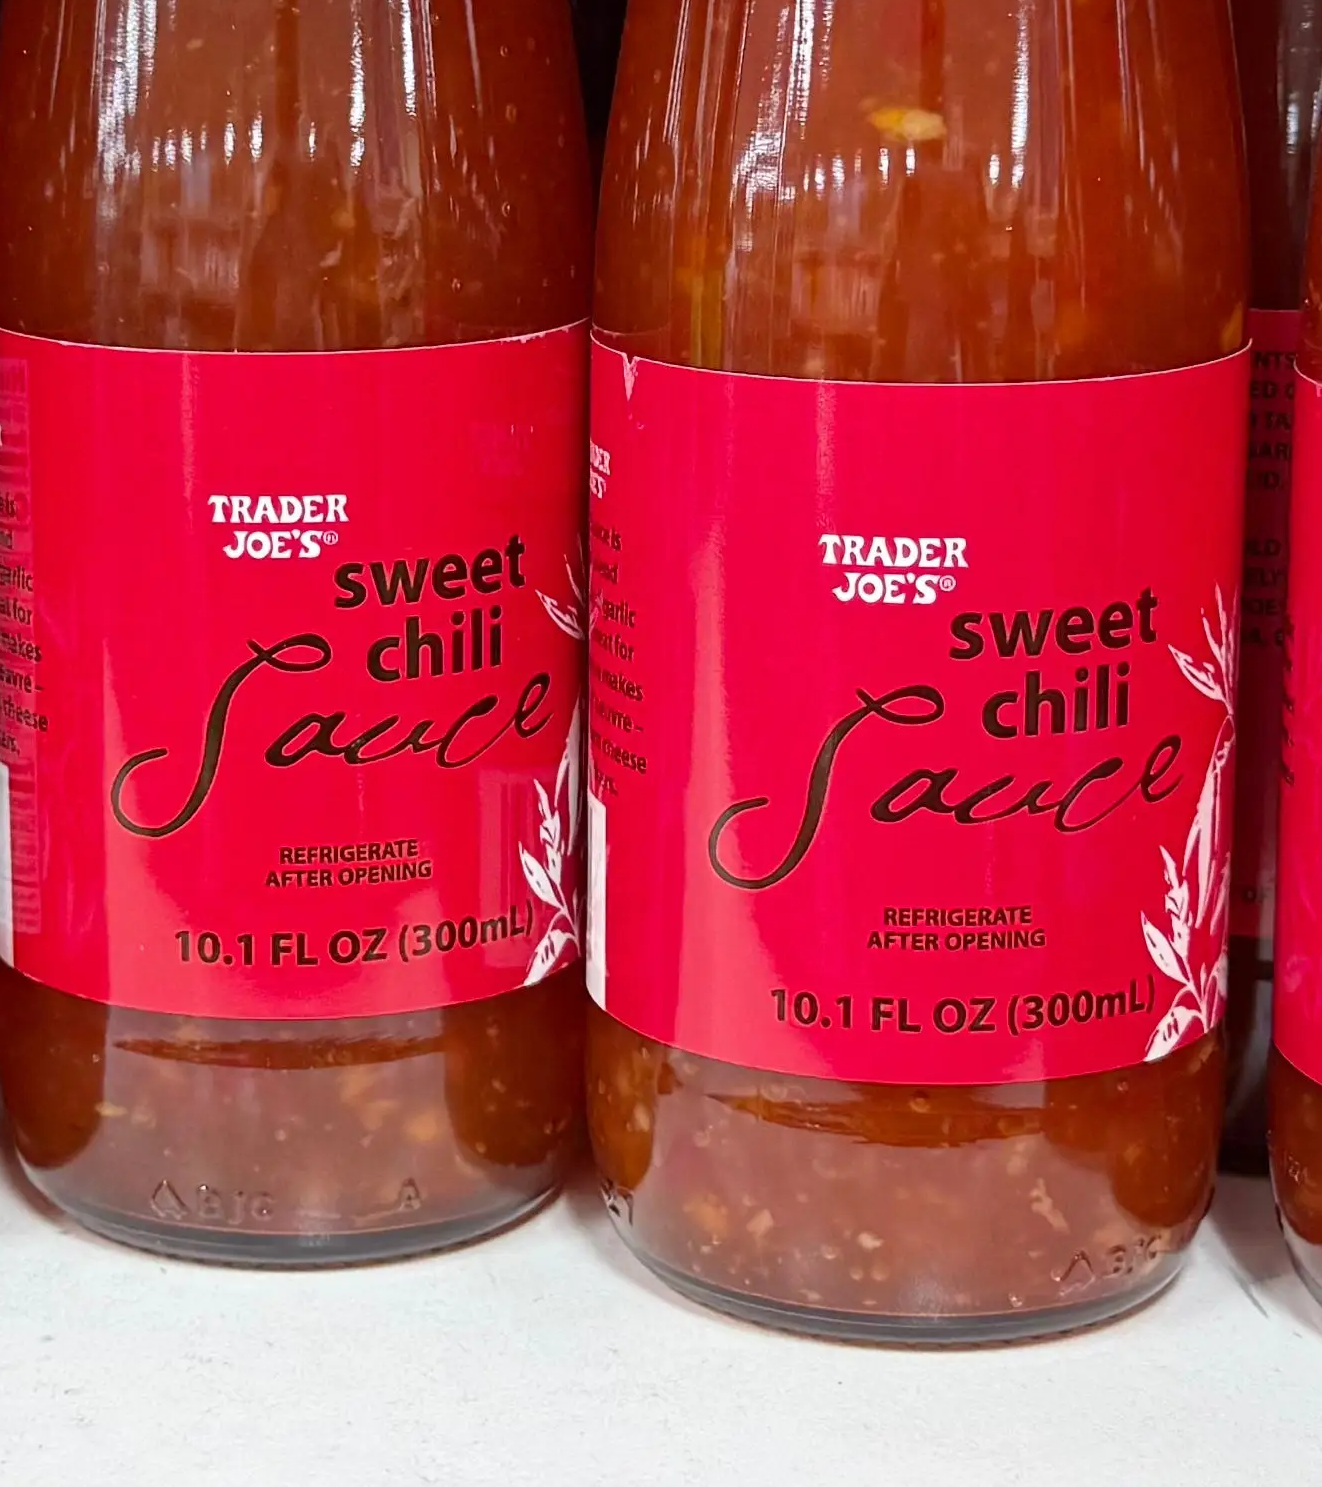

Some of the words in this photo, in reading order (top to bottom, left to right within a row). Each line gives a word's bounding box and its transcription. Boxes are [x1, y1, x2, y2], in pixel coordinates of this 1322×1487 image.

[208, 494, 349, 524] TRADER
[333, 535, 526, 610] sweet
[818, 534, 969, 568] TRADER
[367, 605, 503, 682] chili
[948, 586, 1158, 660] sweet
[982, 661, 1131, 739] chili
[111, 632, 554, 838] Sauce
[707, 684, 1184, 891] Sauce
[266, 866, 333, 889] AFTER
[338, 859, 432, 886] OPENING
[280, 839, 419, 865] REFRIGERATE
[174, 929, 255, 966] 10.1
[271, 932, 318, 966] FL
[328, 929, 387, 965] OZ
[399, 900, 533, 963] (300mL)
[867, 929, 939, 951] AFTER
[945, 928, 1046, 951] OPENING
[883, 905, 1032, 928] REFRIGERATE
[771, 987, 853, 1030] 10.1
[871, 996, 921, 1033] FL
[933, 997, 996, 1033] OZ
[1007, 973, 1155, 1035] (300mL)
